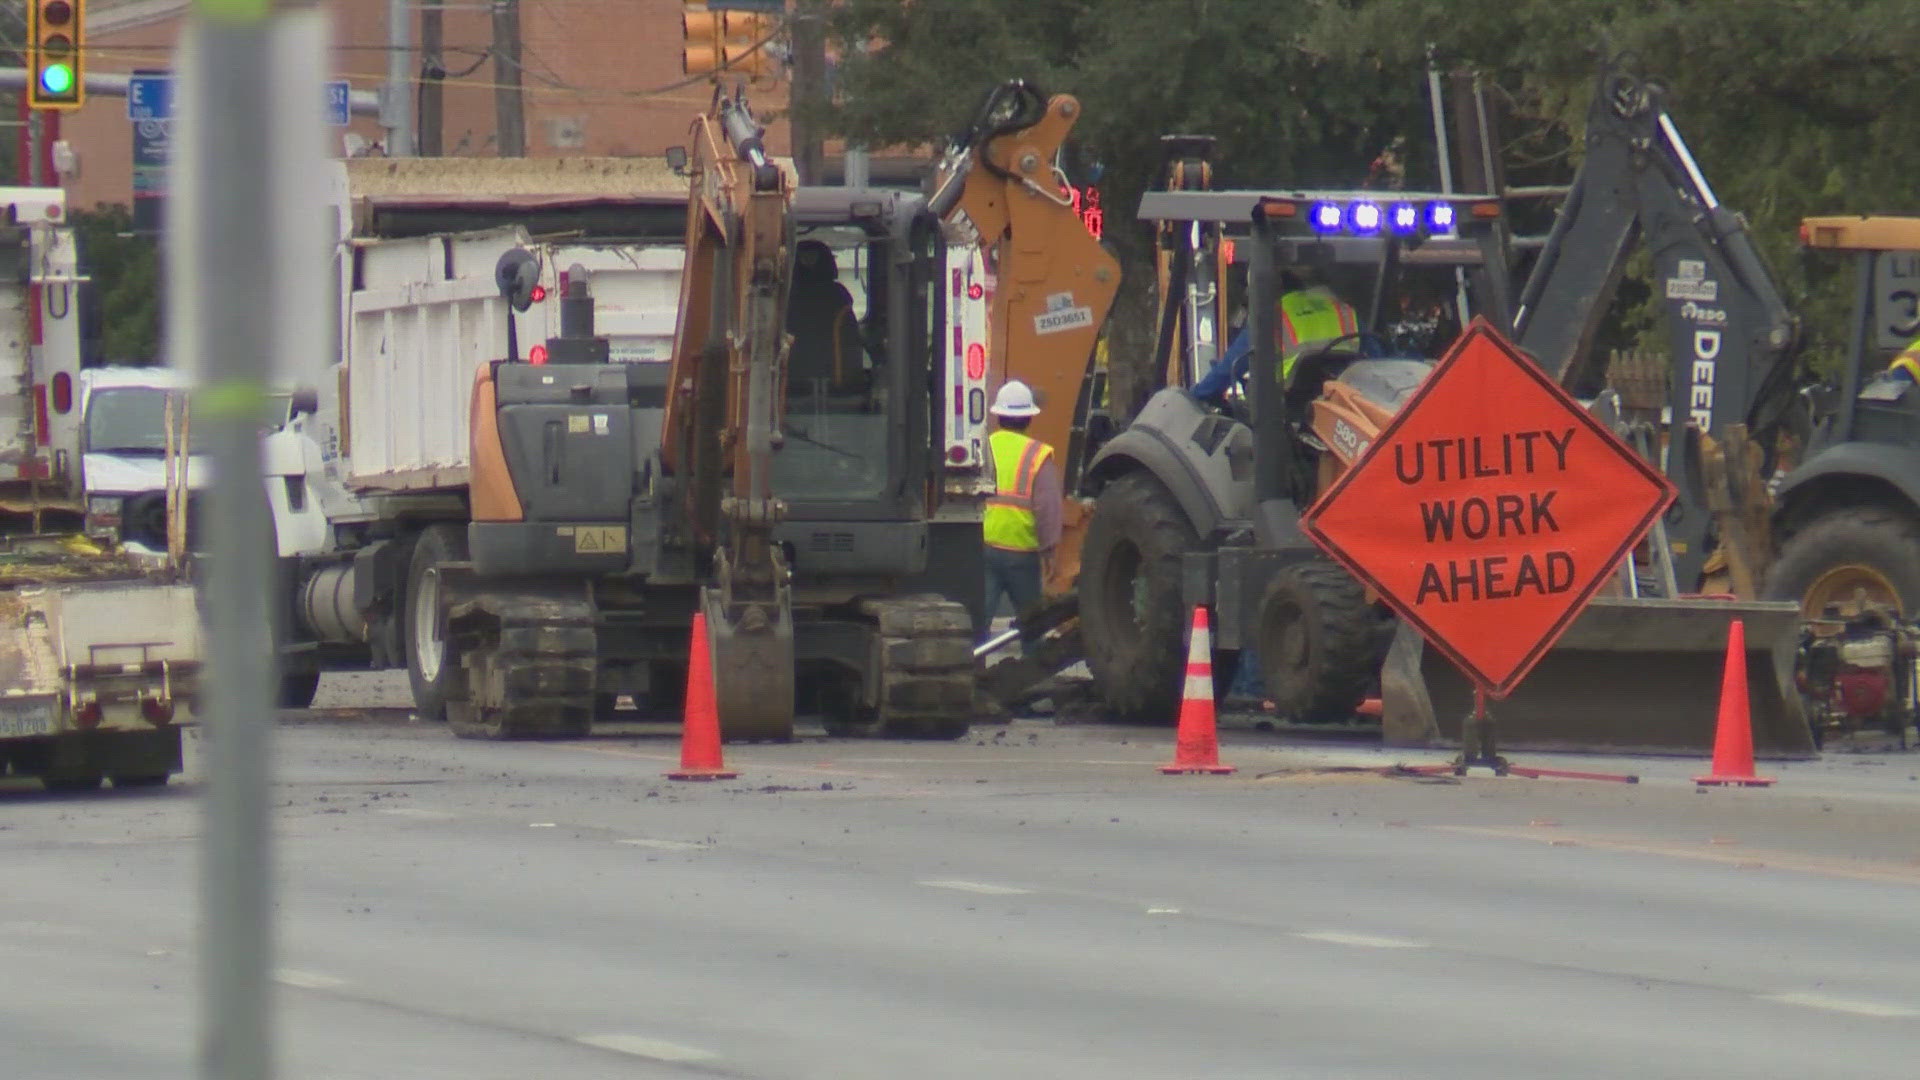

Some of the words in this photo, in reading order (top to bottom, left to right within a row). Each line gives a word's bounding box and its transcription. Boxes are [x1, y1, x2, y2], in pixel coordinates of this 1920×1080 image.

[132, 83, 144, 104] E
[1395, 428, 1576, 485] UTILITY
[1420, 490, 1560, 543] WORK
[1416, 551, 1575, 605] AHEAD
